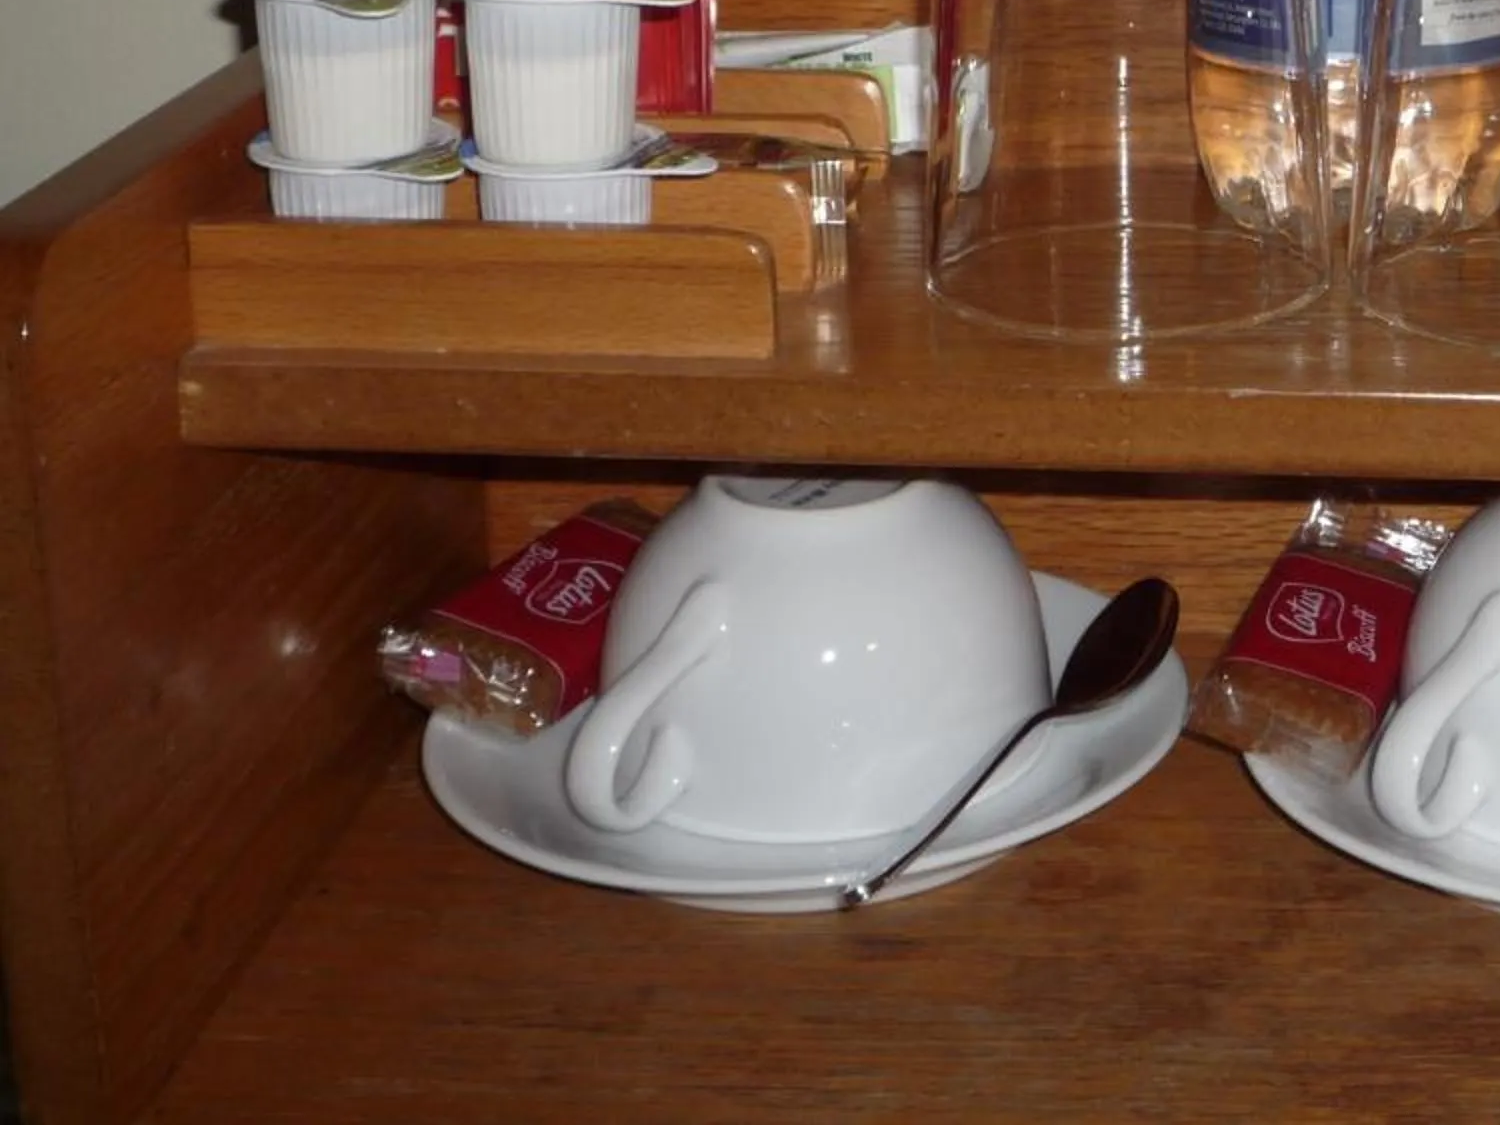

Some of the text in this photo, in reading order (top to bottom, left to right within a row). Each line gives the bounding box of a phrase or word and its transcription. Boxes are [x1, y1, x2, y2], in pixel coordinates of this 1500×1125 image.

[501, 542, 558, 596] Biscoff
[545, 565, 611, 617] Lotus
[1278, 588, 1325, 636] Lotus
[1347, 603, 1377, 663] Biscoff
